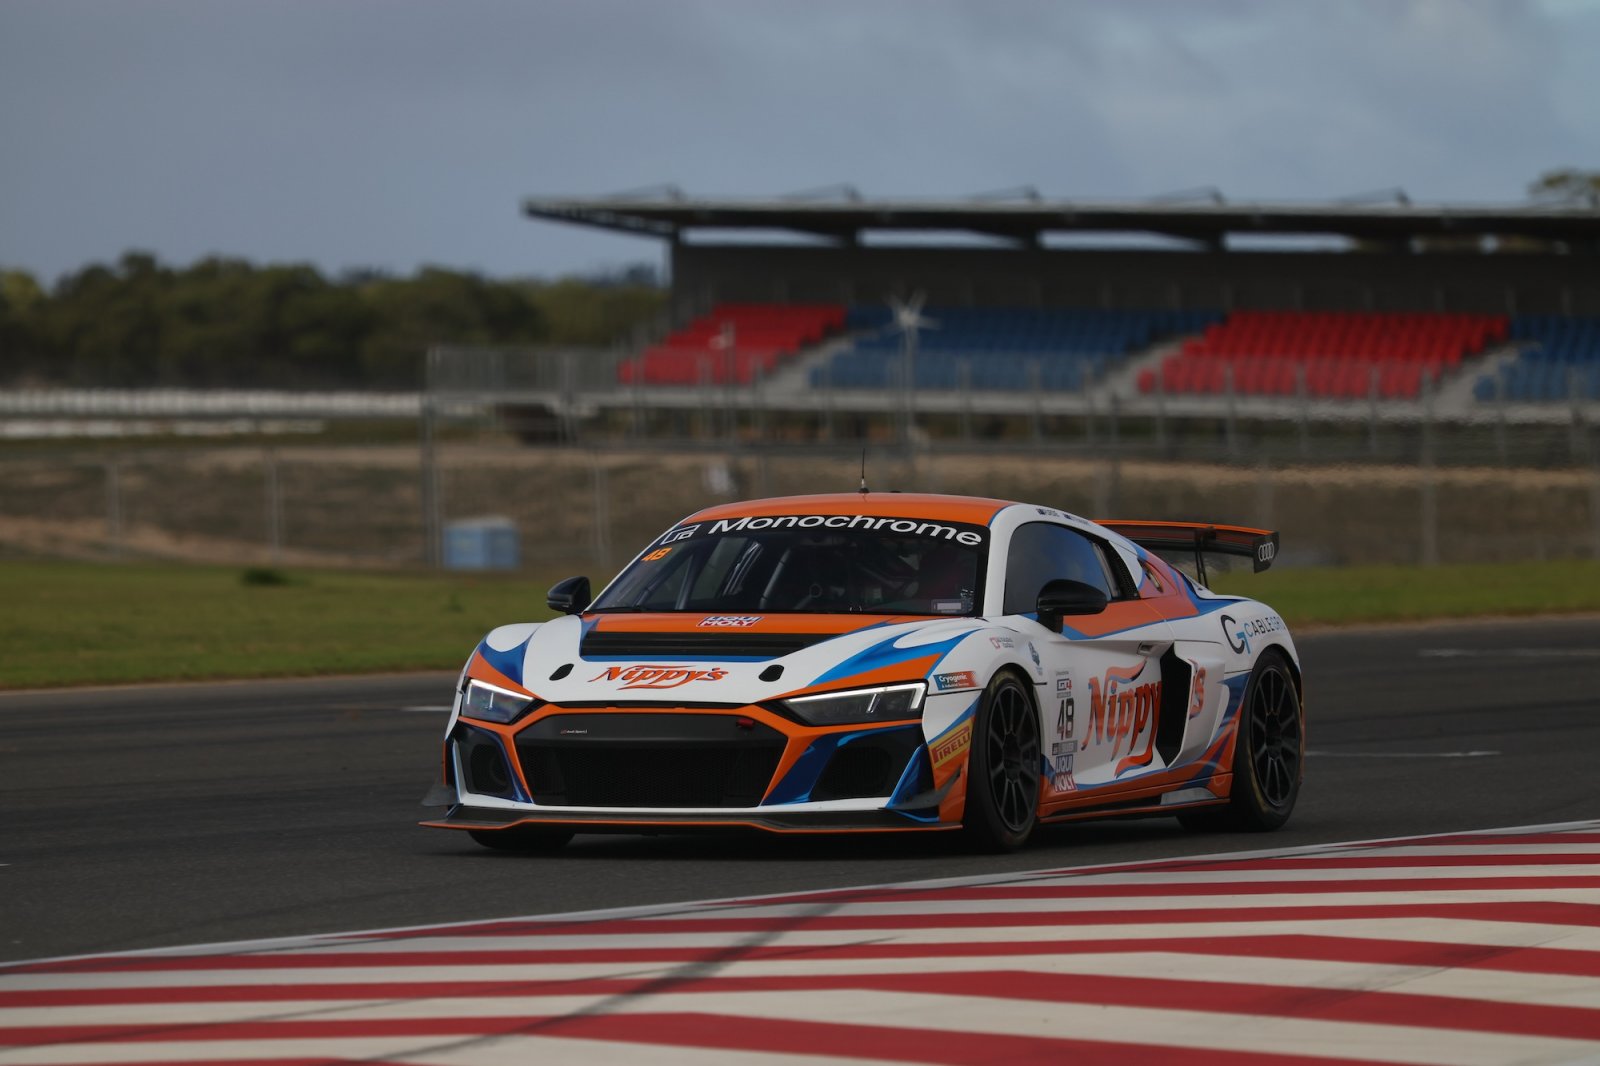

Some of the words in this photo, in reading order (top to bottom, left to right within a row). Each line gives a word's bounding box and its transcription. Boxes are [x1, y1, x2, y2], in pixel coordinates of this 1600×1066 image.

[707, 515, 983, 546] Monochrome
[641, 547, 673, 562] 48
[587, 665, 729, 690] Nippy's
[939, 673, 968, 683] Cryogenic
[1056, 698, 1075, 741] 48
[931, 726, 971, 764] PIRELLI
[1056, 756, 1073, 774] LIQUI
[1054, 775, 1076, 792] MOLY
